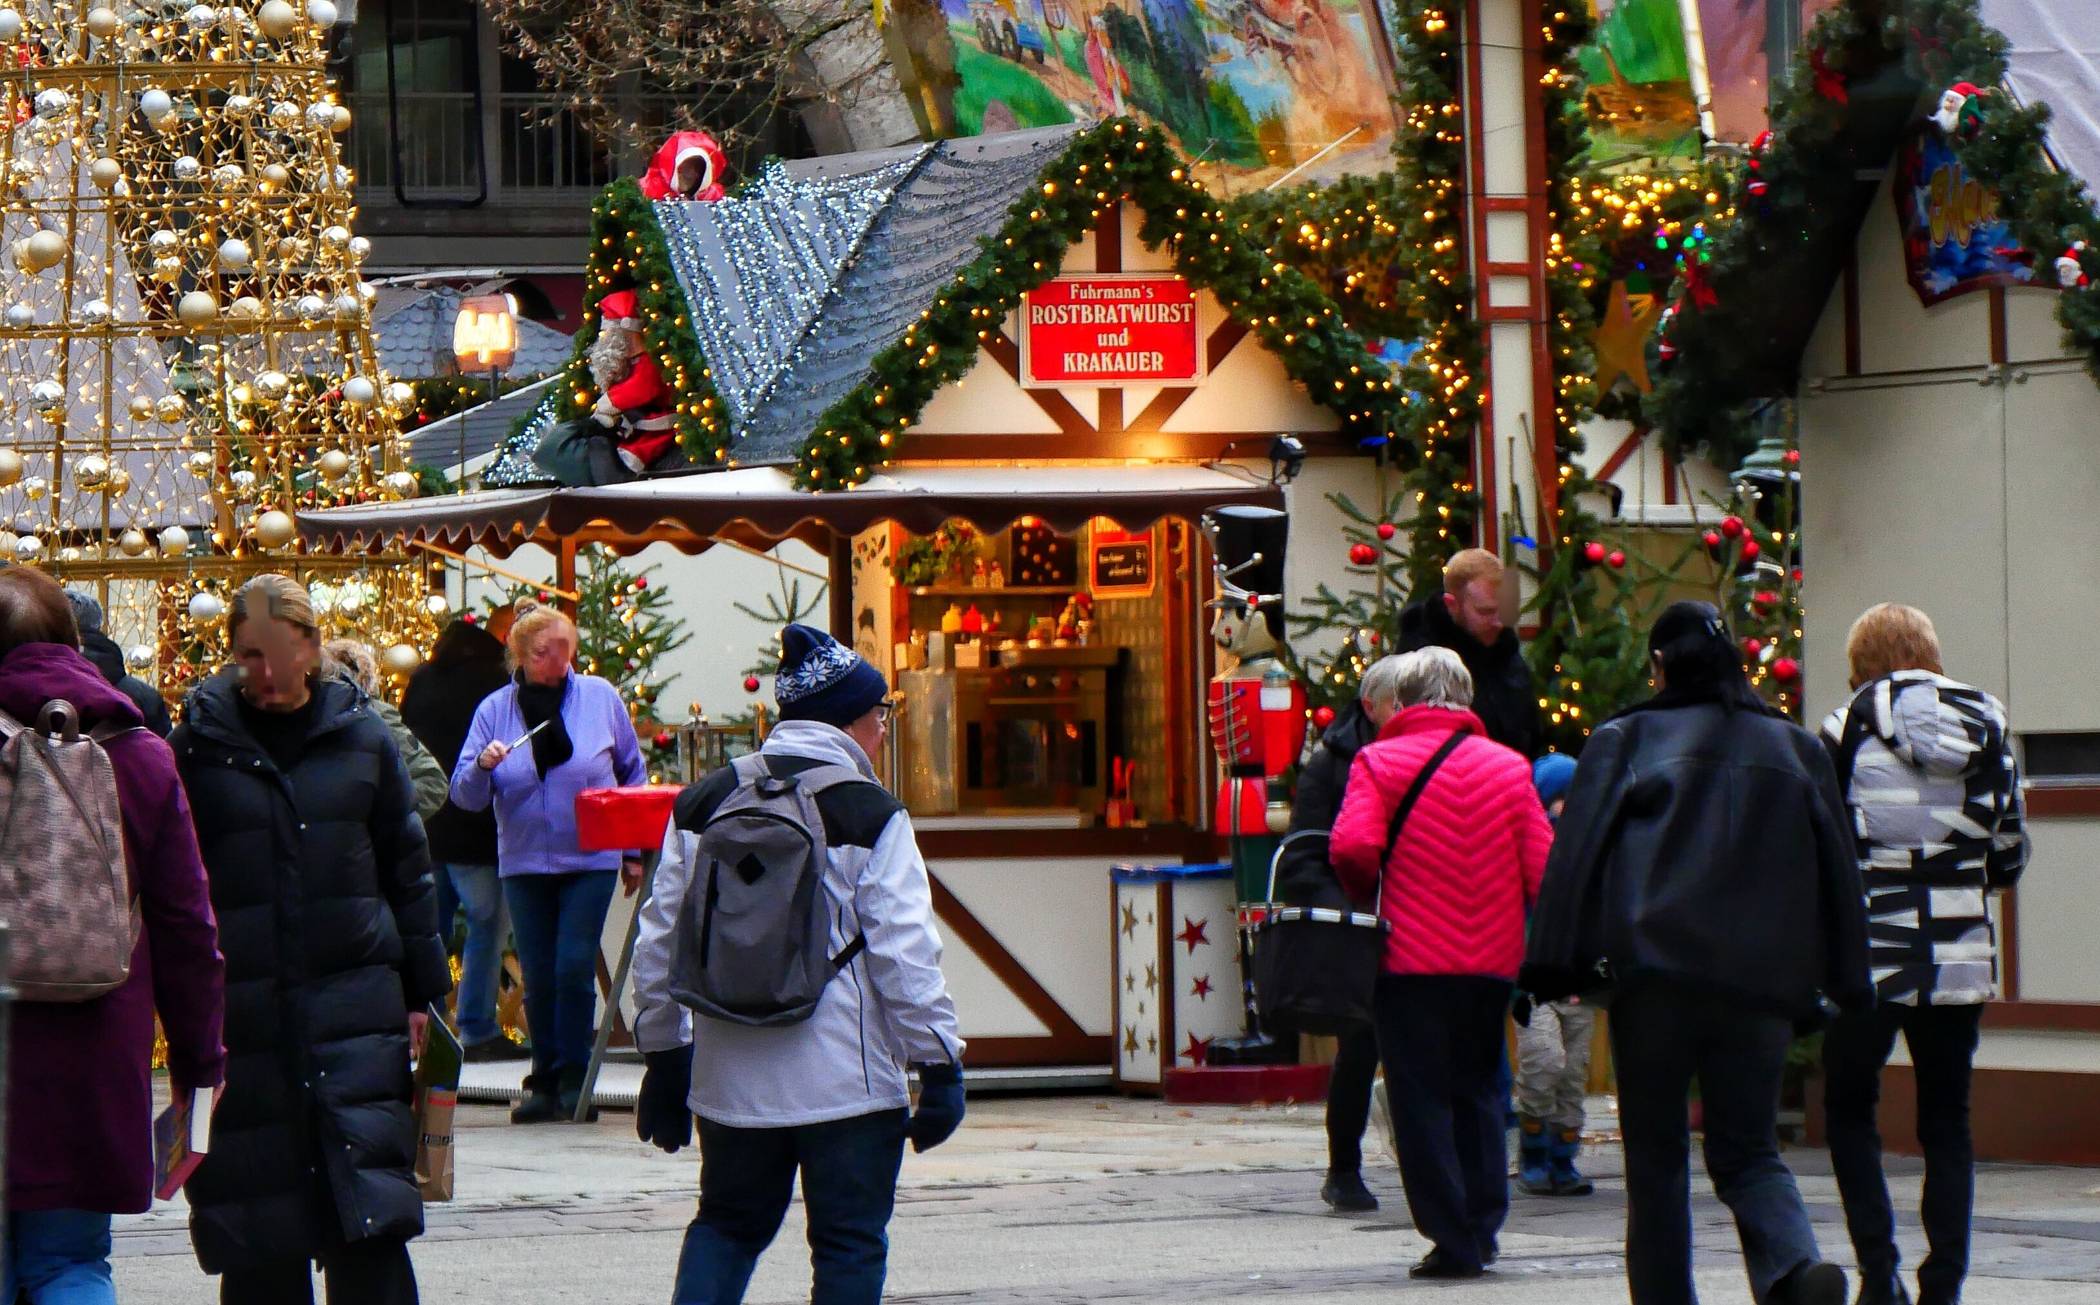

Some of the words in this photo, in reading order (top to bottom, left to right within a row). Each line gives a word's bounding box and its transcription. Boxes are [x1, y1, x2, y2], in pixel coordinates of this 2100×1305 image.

[1070, 283, 1154, 300] Fuhrmann's
[1032, 303, 1193, 325] ROSTBRATWURST
[1097, 327, 1129, 347] und
[1063, 351, 1164, 373] KRAKAUER
